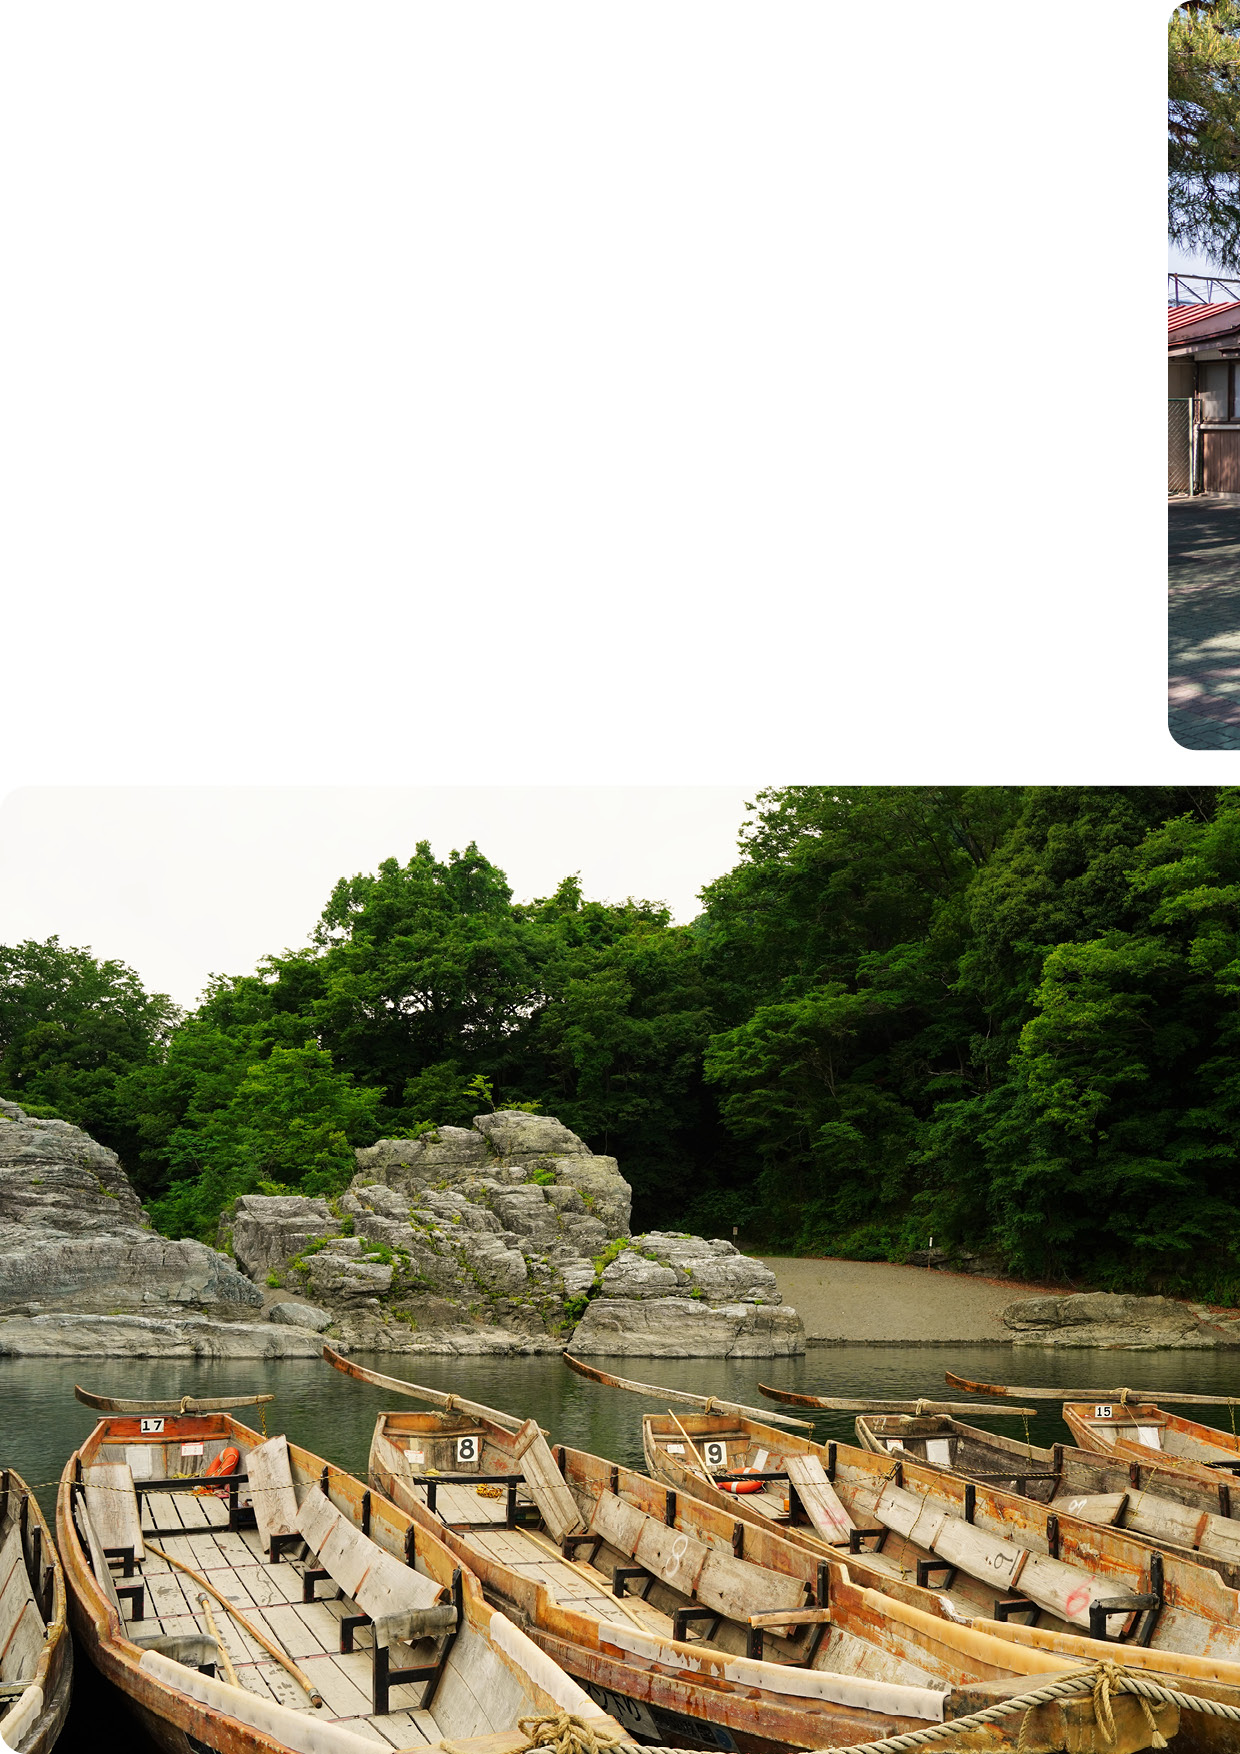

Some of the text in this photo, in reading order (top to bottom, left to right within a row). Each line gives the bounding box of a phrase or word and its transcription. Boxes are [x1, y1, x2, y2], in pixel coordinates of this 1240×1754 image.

[1096, 1406, 1111, 1417] 15
[142, 1420, 162, 1431] 17
[459, 1438, 475, 1459] 8
[707, 1443, 722, 1464] 9
[665, 1535, 689, 1578] 8
